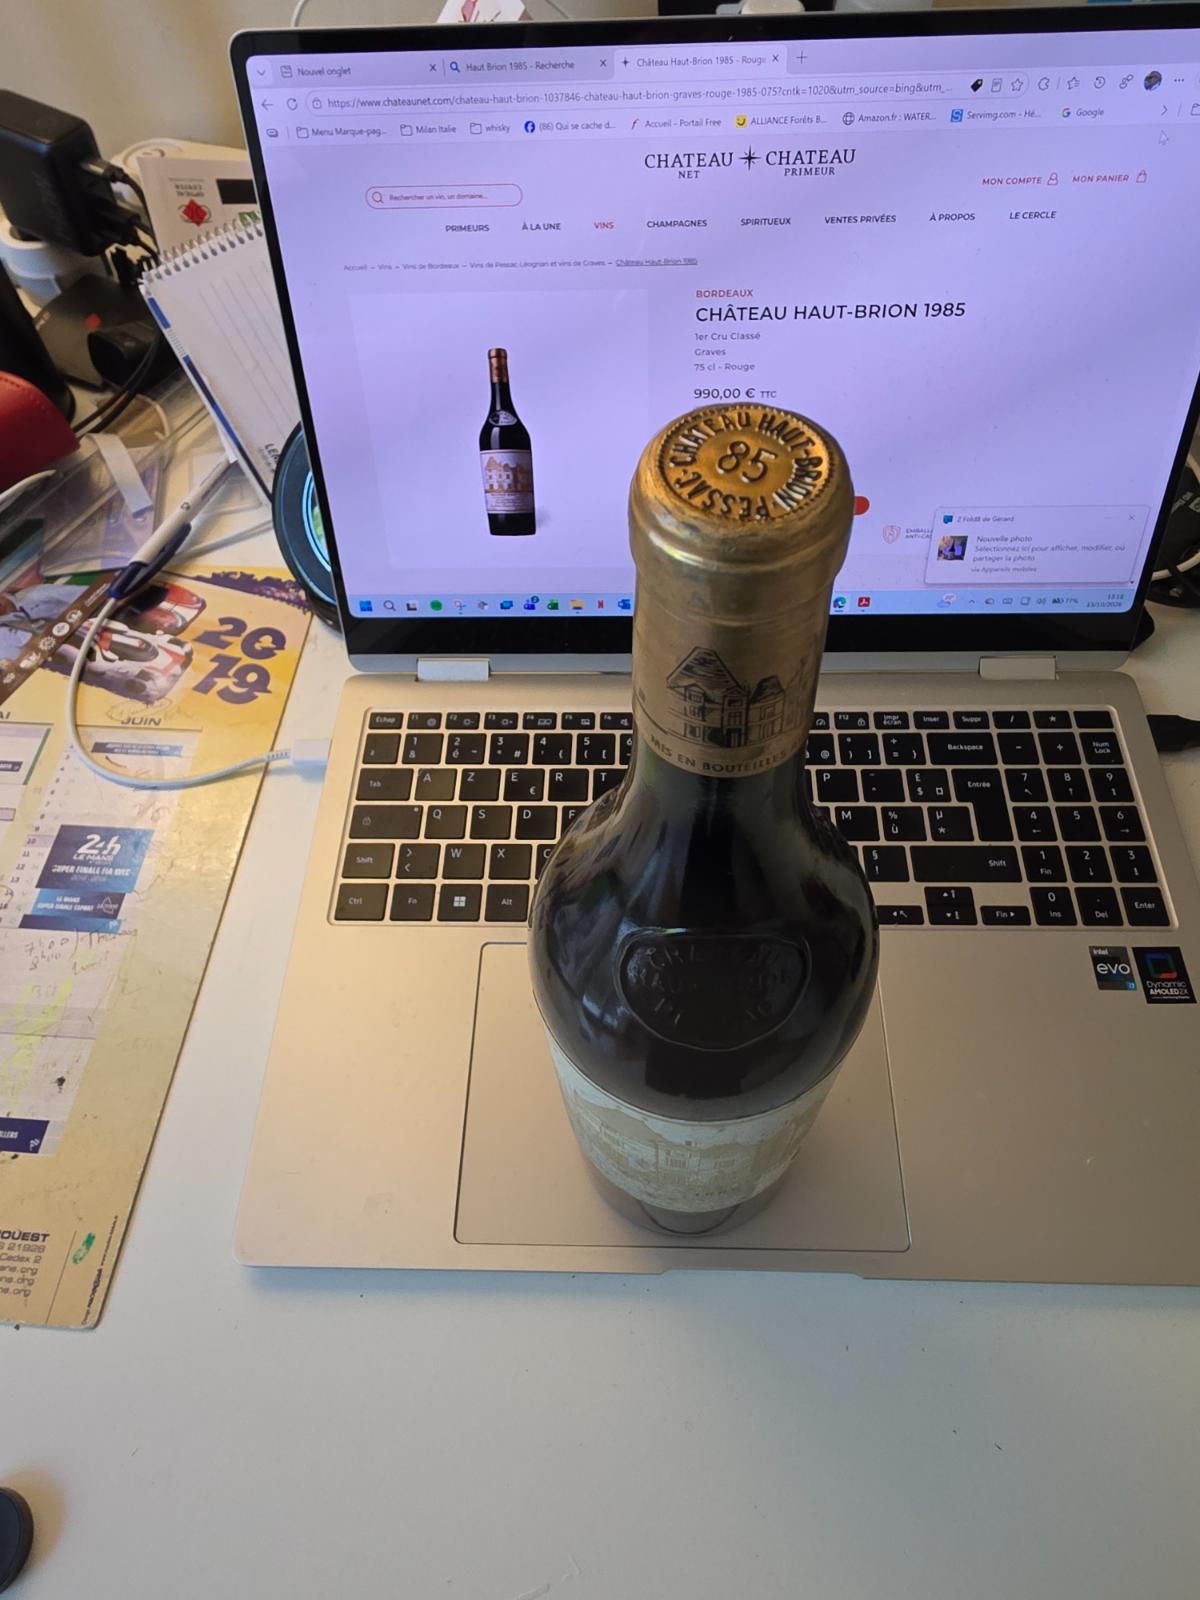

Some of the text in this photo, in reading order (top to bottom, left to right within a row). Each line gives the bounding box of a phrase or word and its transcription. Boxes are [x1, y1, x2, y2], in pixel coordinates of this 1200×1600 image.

[466, 60, 575, 72] Haut Brion 1985 Recherche
[636, 55, 734, 67] Château Haut-Brion 1985
[298, 67, 351, 78] Nouvel onglet
[858, 113, 898, 123] Amazon.fr
[966, 110, 1016, 121] Servimg.com
[1076, 107, 1105, 119] Google
[645, 118, 722, 128] Accueil Portail Free
[751, 116, 788, 126] ALLIANCE
[790, 115, 813, 124] Forêts
[416, 124, 457, 134] Milan Italie
[485, 123, 510, 134] whisky
[539, 121, 554, 132] (86)
[555, 121, 569, 131] Qui
[581, 120, 602, 130] cache
[312, 128, 333, 136] Menu
[644, 151, 734, 169] CHATEAU
[765, 148, 857, 166] CHATEAU
[678, 170, 701, 179] NET
[784, 167, 836, 177] PRIMEUR
[982, 176, 1042, 186] MON COMPTE
[1072, 174, 1130, 183] MON PANIER
[824, 213, 897, 225] VENTES PRIVÉES
[929, 212, 976, 222] À PROPOS
[1009, 210, 1057, 220] LE CERCLE
[521, 221, 561, 231] À LA UNE
[594, 221, 615, 230] VINS
[646, 218, 708, 229] CHAMPAGNES
[740, 217, 792, 226] SPIRITUEUX
[445, 224, 490, 233] PRIMEURS
[695, 288, 754, 299] BORDEAUX
[695, 302, 967, 323] CHÂTEAU HAUT-BRION 1985
[694, 331, 761, 342] 1er Cru Classé
[694, 348, 727, 357] Graves
[693, 362, 756, 372] 75 cl Rouge
[693, 387, 778, 401] 990,00 € TTC
[668, 411, 752, 469] CHATEAU
[716, 440, 779, 484] 85
[977, 535, 1033, 543] Nouvelle photo
[1031, 546, 1049, 554] pour
[973, 556, 1003, 564] partager
[1012, 555, 1036, 563] photo
[192, 616, 288, 660] 20
[192, 653, 273, 705] 19
[121, 716, 162, 726] JUIN
[961, 716, 982, 724] Suppr
[947, 743, 984, 752] Backspace
[677, 752, 696, 768] EN
[369, 779, 382, 788] Tab
[967, 780, 992, 788] Entrée
[356, 855, 374, 865] Shift
[988, 859, 1007, 867] Shift
[52, 864, 75, 873] SUPER
[75, 865, 100, 875] FINALE
[1040, 867, 1052, 875] Fin
[348, 896, 363, 905] Ctrl
[407, 897, 418, 905] Fn
[501, 897, 513, 906] Alt
[1134, 901, 1156, 910] Enter
[1049, 910, 1062, 918] Ins
[1095, 911, 1109, 919] Del
[1096, 963, 1131, 975] evo
[1146, 981, 1187, 989] Dynamic
[33, 1255, 42, 1264] 2
